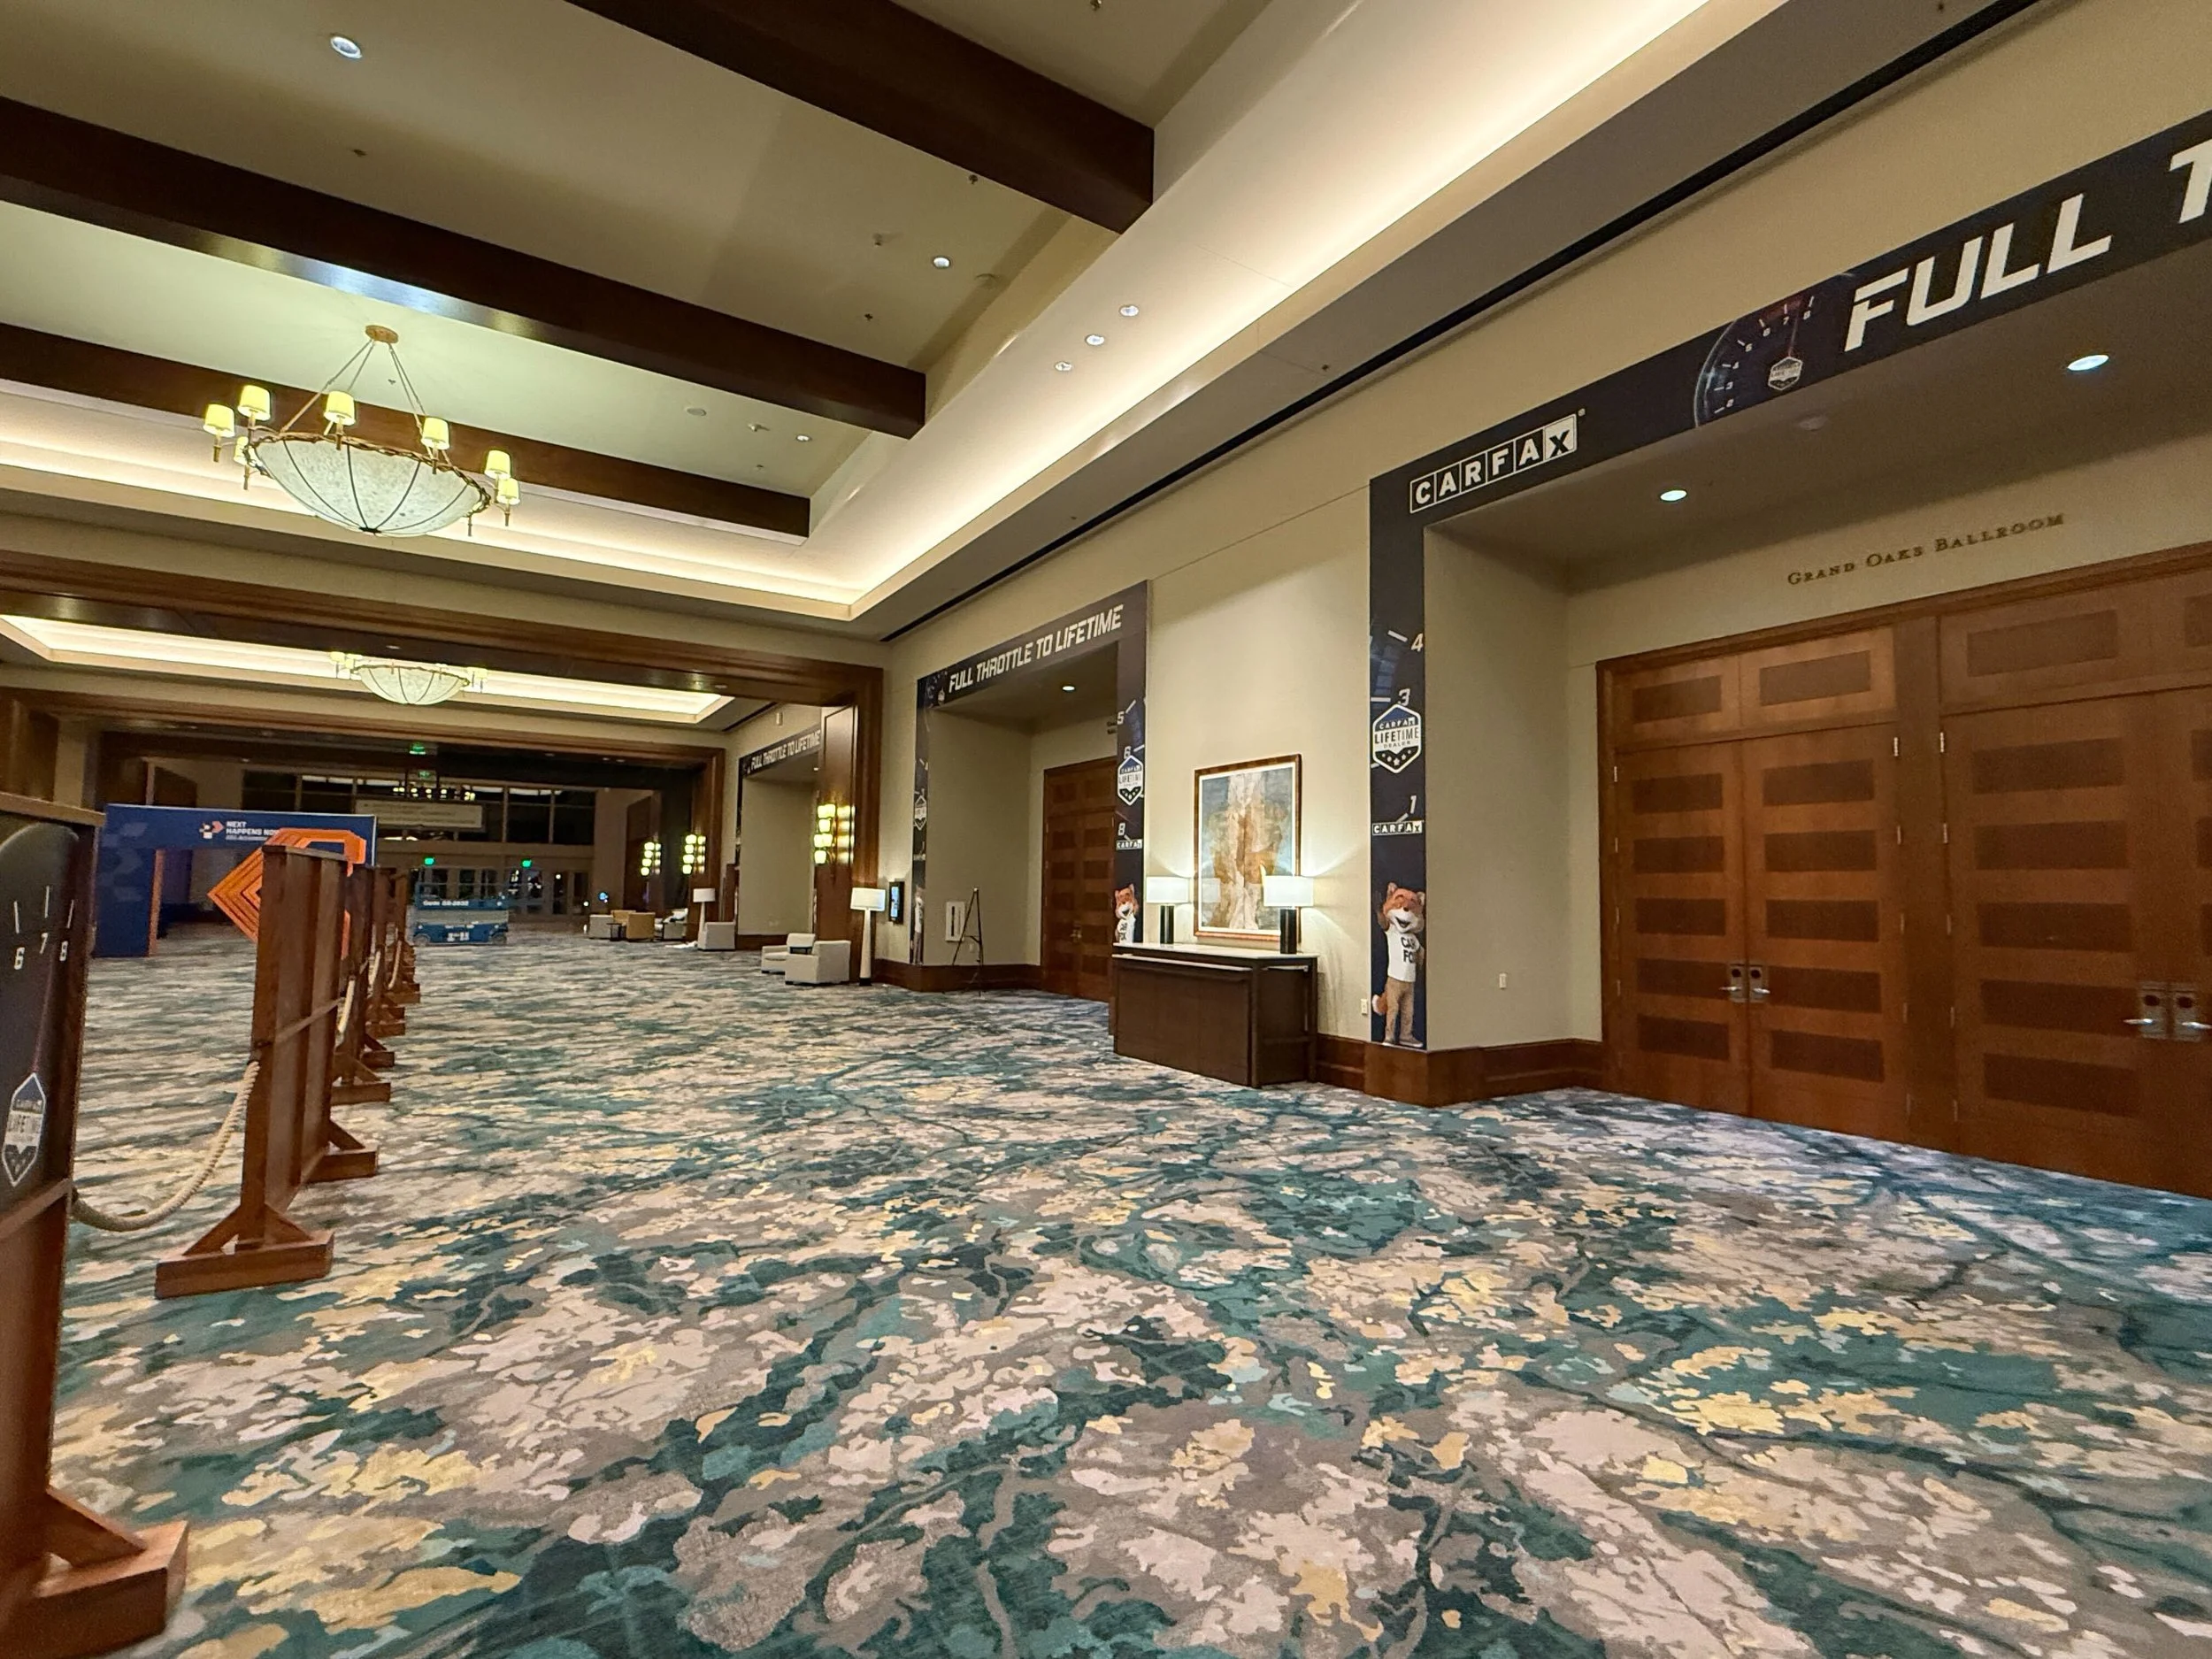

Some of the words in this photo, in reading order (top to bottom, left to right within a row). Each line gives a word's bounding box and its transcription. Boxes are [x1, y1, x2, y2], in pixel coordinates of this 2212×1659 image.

[1845, 193, 2112, 352] FULL
[1415, 429, 1571, 505] CARFAX
[949, 667, 973, 694] FULL
[976, 641, 1034, 683] THROTTLE
[1036, 633, 1054, 660] TO
[1055, 603, 1125, 653] LIFETIME
[1410, 632, 1424, 652] 4
[1398, 688, 1411, 706] 3
[1117, 710, 1125, 726] 5
[1374, 726, 1419, 745] LIFETIME
[1118, 822, 1125, 836] 8
[1373, 823, 1421, 833] CARFAX
[39, 932, 49, 955] 7
[59, 940, 69, 962] 8
[14, 947, 26, 970] 6
